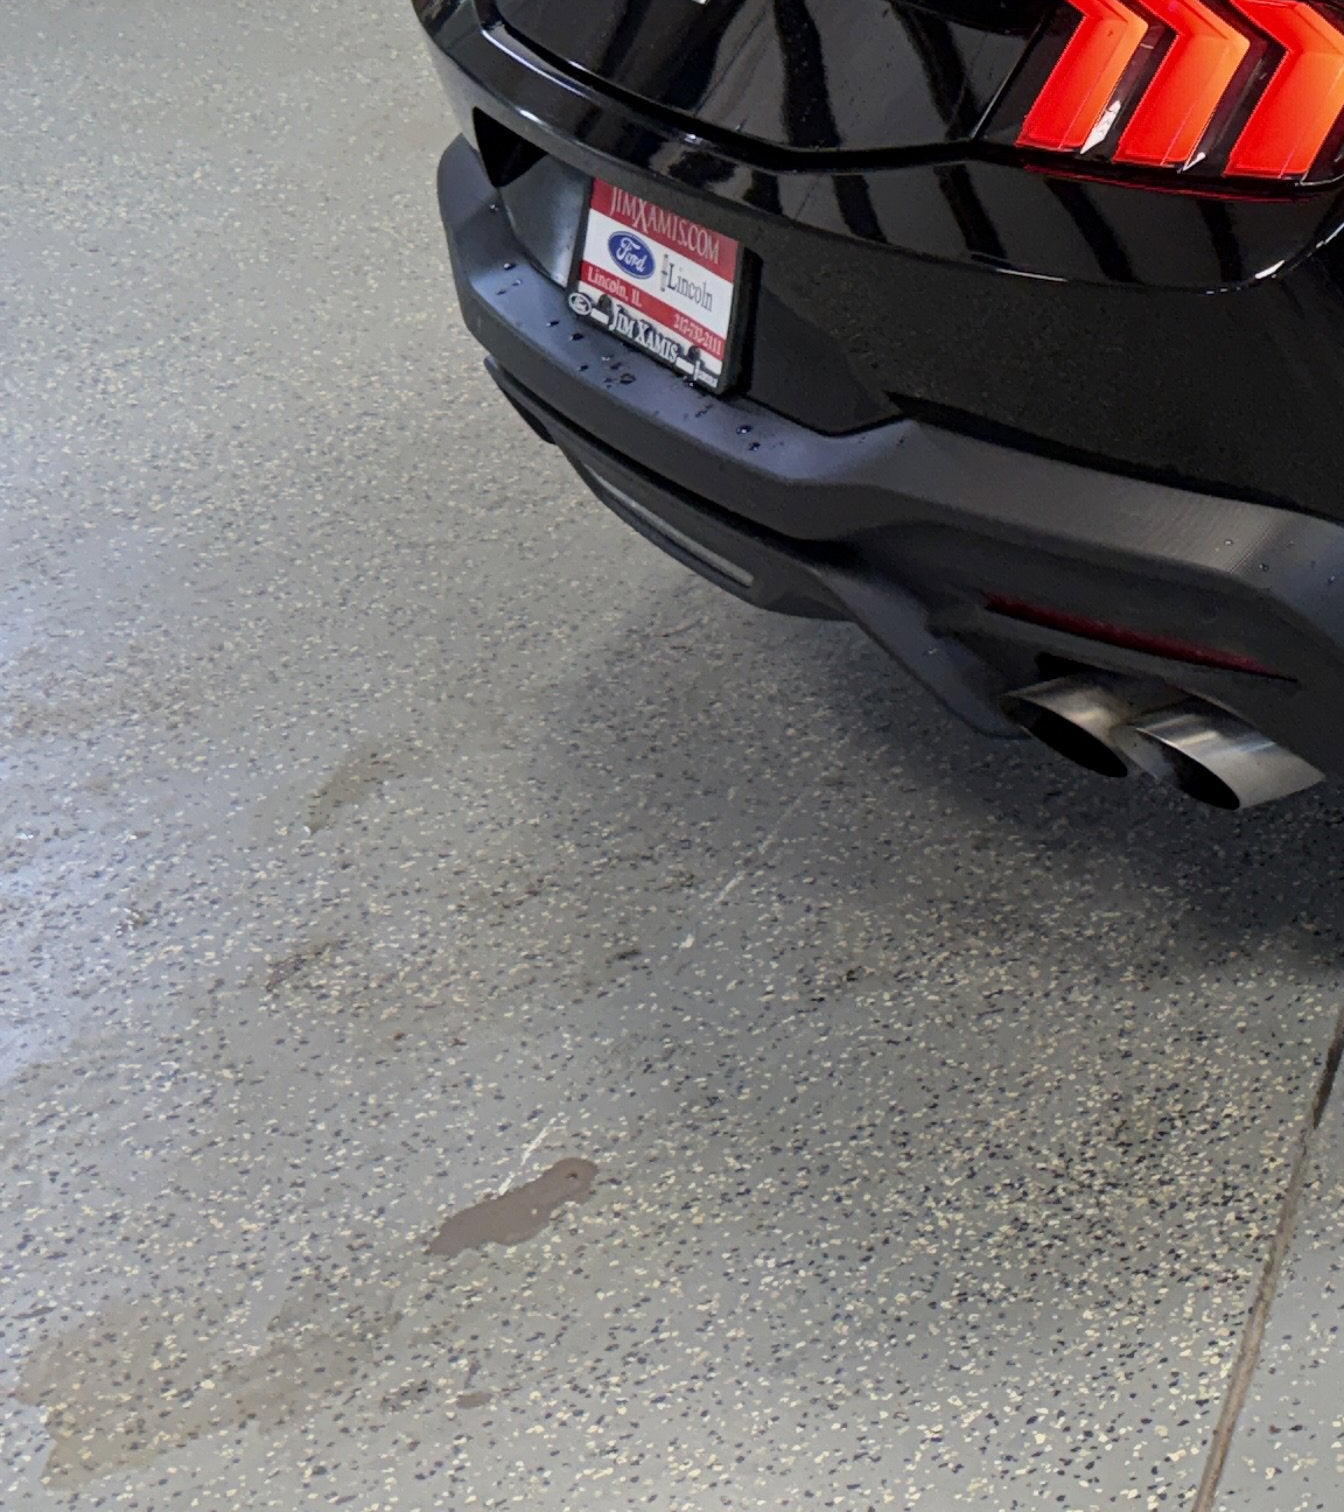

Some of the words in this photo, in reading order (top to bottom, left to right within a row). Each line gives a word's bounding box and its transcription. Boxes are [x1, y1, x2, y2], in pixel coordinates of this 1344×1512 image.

[609, 186, 720, 265] JIMXAMIS.COM
[615, 236, 649, 273] Ford
[587, 266, 629, 302] Lincoln,
[631, 289, 643, 308] IL
[667, 262, 713, 312] Lincoln
[609, 304, 635, 338] JIM
[634, 319, 679, 364] XAMIS
